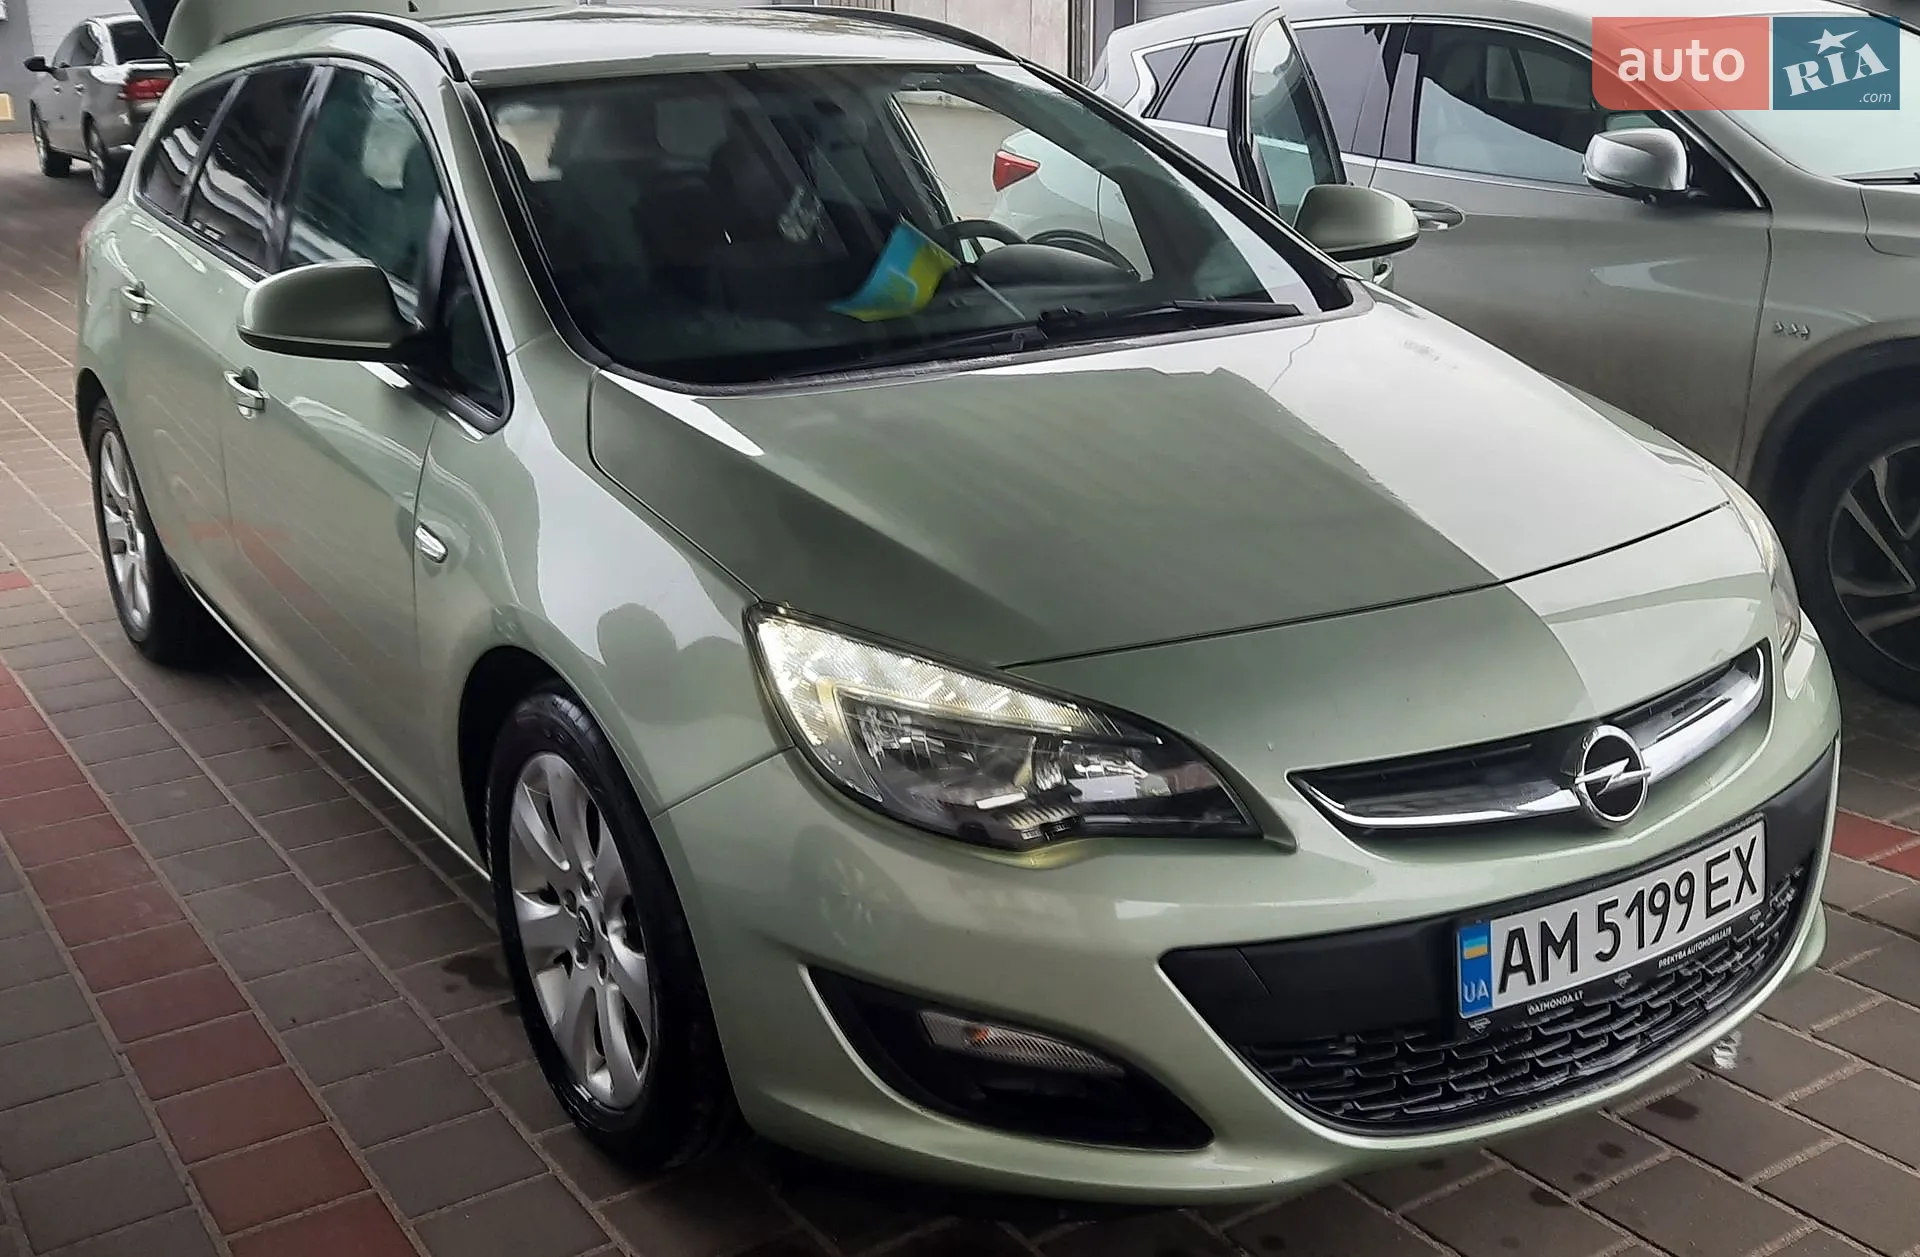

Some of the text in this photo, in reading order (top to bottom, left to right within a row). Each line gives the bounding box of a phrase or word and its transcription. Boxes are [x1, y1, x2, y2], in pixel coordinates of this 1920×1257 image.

[1498, 836, 1757, 994] AM 5199 EX
[1463, 979, 1489, 1003] UA
